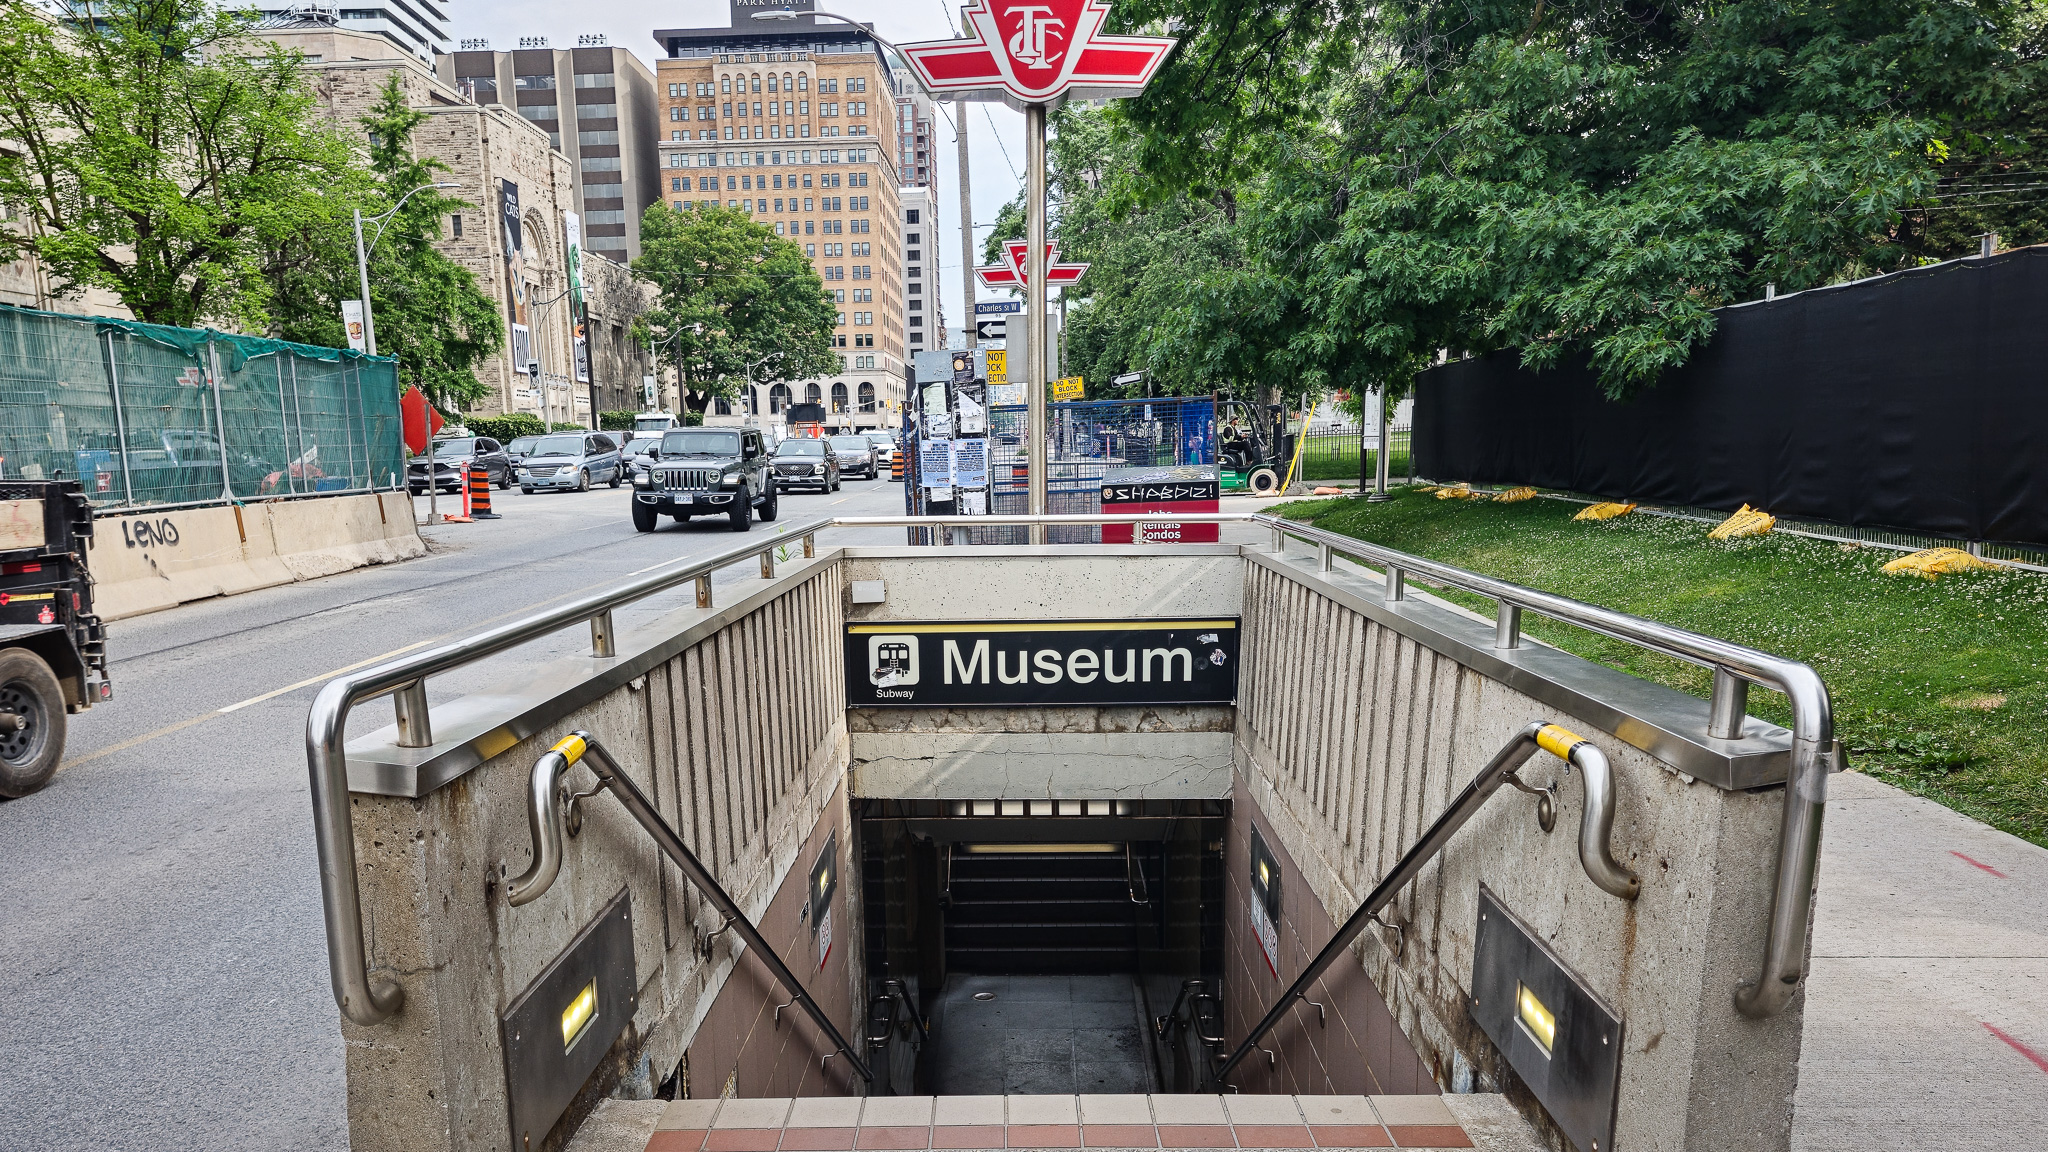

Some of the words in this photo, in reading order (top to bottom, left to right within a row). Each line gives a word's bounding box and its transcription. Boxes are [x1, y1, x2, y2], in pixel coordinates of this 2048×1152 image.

[504, 202, 520, 219] CATS
[978, 304, 1002, 313] Charles
[1011, 303, 1017, 311] W
[987, 352, 1004, 361] NOT
[942, 638, 1193, 685] Museum
[876, 689, 914, 700] Subway
